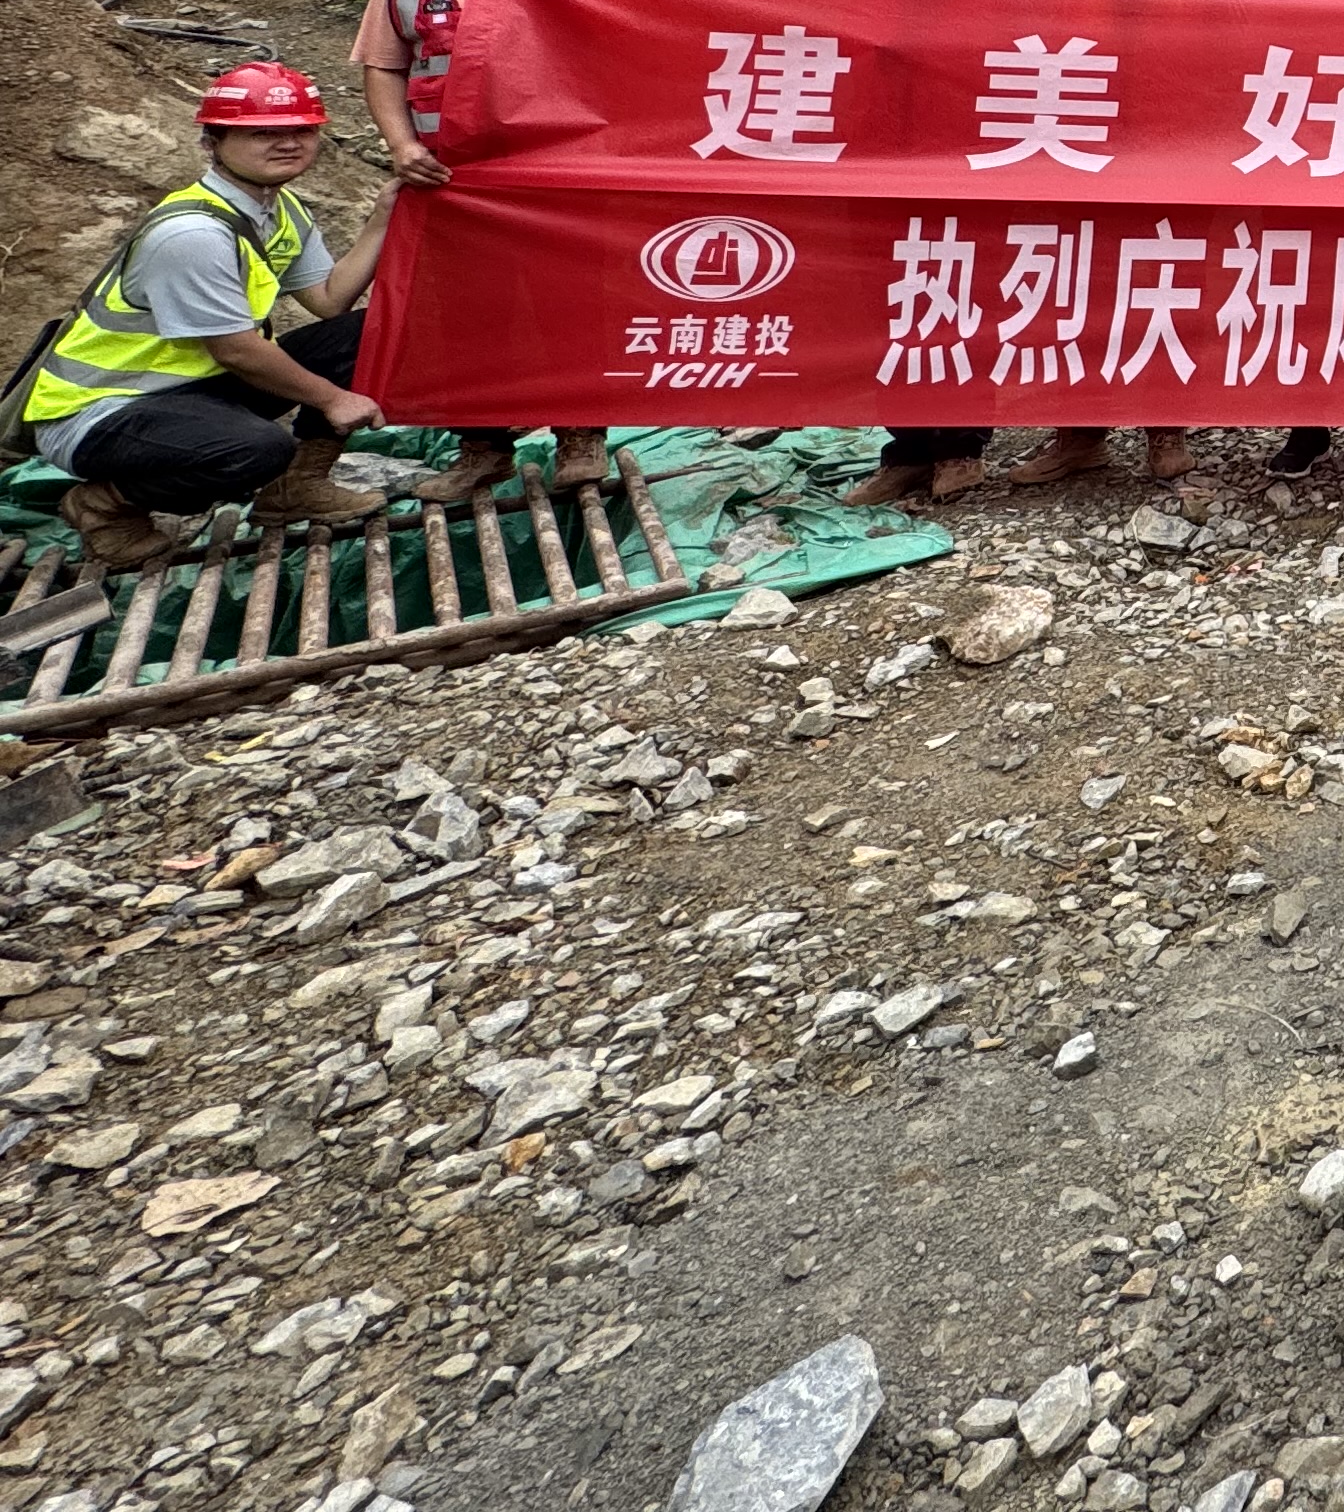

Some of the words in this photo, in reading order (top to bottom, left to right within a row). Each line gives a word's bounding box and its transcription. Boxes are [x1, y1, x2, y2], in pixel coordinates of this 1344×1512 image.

[625, 314, 794, 355] 云南建投
[645, 362, 757, 388] YCIH
